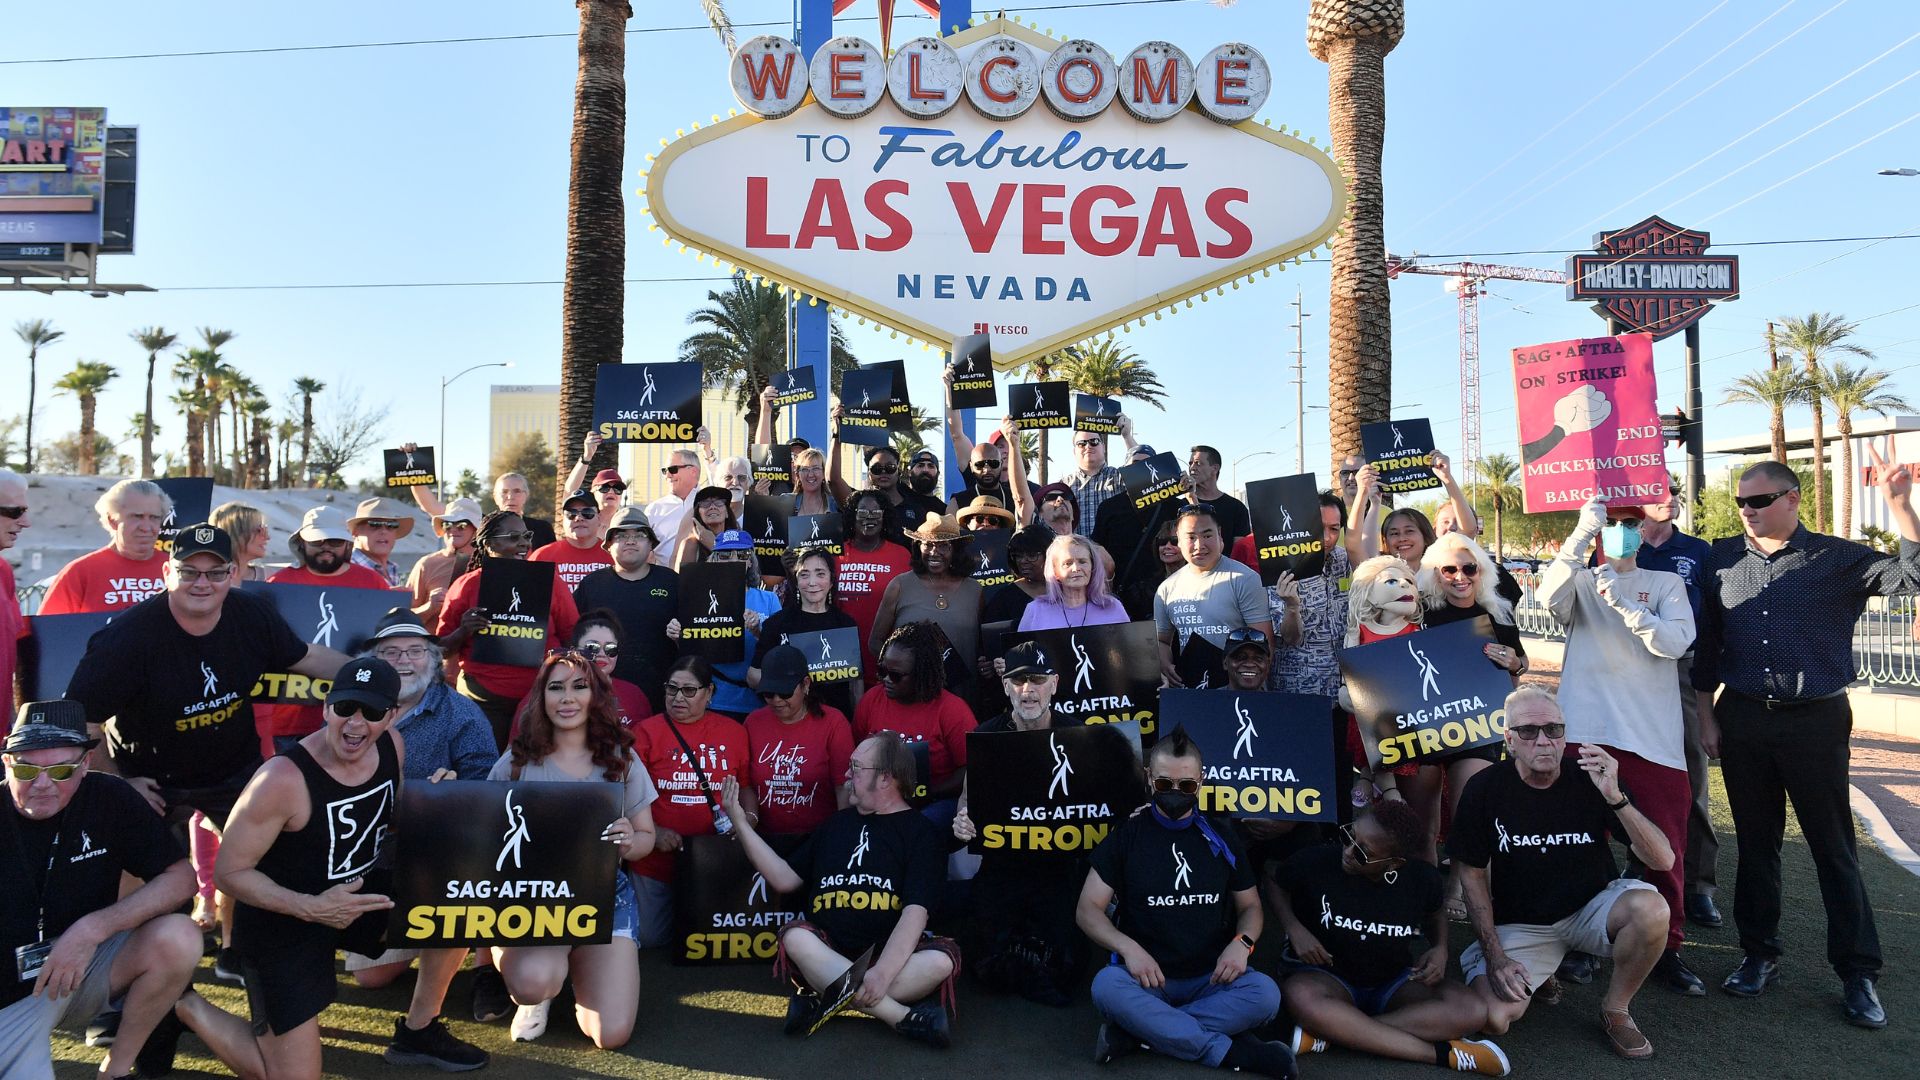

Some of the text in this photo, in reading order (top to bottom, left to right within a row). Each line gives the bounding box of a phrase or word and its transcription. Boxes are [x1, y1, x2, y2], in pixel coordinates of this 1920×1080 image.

[741, 53, 1251, 106] WELCOME
[1, 139, 65, 163] ART
[796, 126, 1189, 174] TO Fabulous
[746, 176, 1253, 260] LAS VEGAS
[1617, 226, 1697, 256] MOTOR
[1584, 262, 1730, 291] HARLEY-DAVIDSON
[896, 273, 1092, 303] NEVADA
[1617, 298, 1696, 330] CYCLES
[993, 325, 1028, 336] YESCO
[1517, 341, 1626, 366] SAG AFTRA
[952, 380, 993, 391] STRONG
[1519, 365, 1627, 390] ON STRIKE!
[772, 391, 815, 407] STRONG
[841, 417, 888, 428] STRONG
[1076, 421, 1121, 434] STRONG
[600, 422, 694, 441] STRONG
[1617, 425, 1658, 441] END
[387, 473, 436, 487] STRONG
[753, 471, 790, 482] STRONG
[1545, 483, 1664, 504] BARGAINING
[1259, 540, 1323, 560] STRONG
[840, 562, 891, 573] WORKERS
[109, 577, 167, 591] VEGA
[839, 572, 876, 582] NEED A
[976, 574, 1015, 587] RONG
[837, 581, 872, 592] RAISE.
[104, 590, 158, 605] STRO
[477, 624, 544, 640] STRONG
[682, 626, 742, 639] STRONG
[1178, 625, 1230, 636] EAMSTERS&
[808, 666, 859, 682] TRONG
[1052, 694, 1133, 714] AG·AFTRA
[657, 778, 698, 790] WORKERS
[1198, 782, 1322, 815] TRONG
[983, 823, 1113, 851] STRON
[405, 904, 599, 940] STRONG
[685, 931, 779, 961] STRO
